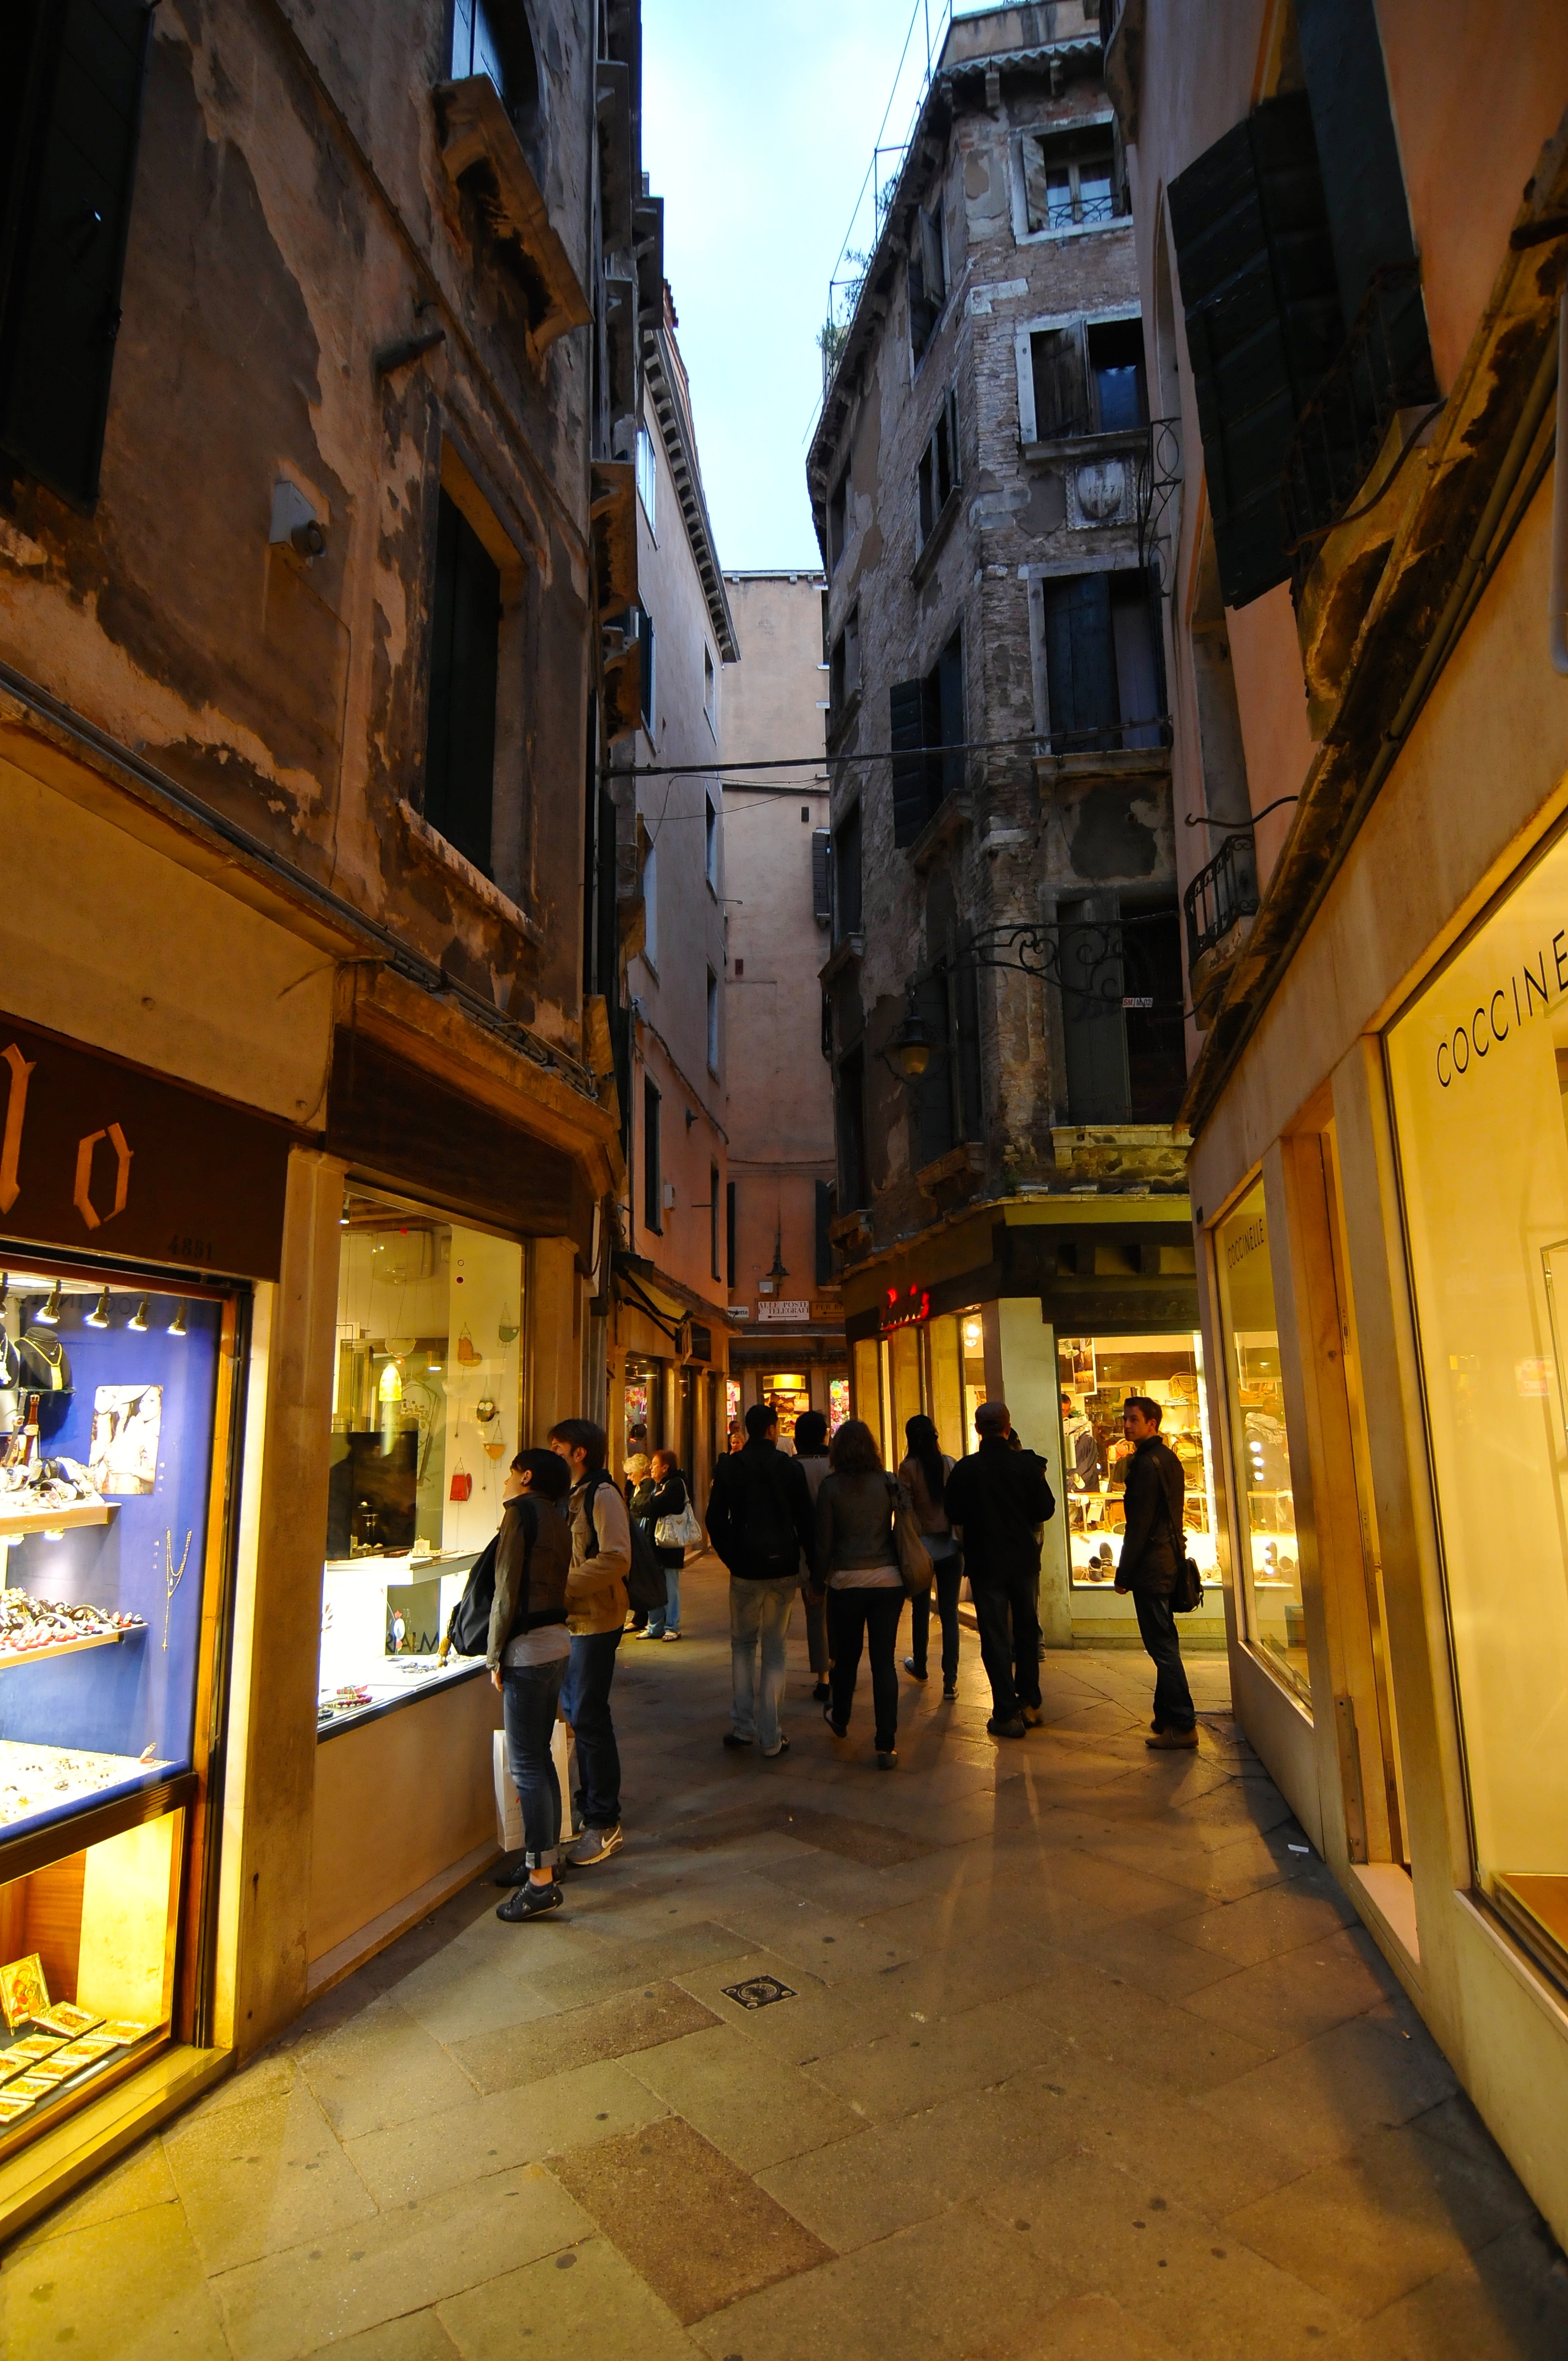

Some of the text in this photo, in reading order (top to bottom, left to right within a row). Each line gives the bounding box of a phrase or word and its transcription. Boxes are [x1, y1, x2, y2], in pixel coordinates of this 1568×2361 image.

[1436, 929, 1568, 1088] COCCINE
[167, 1234, 213, 1261] 4851
[1228, 1218, 1264, 1268] COCCINELLE
